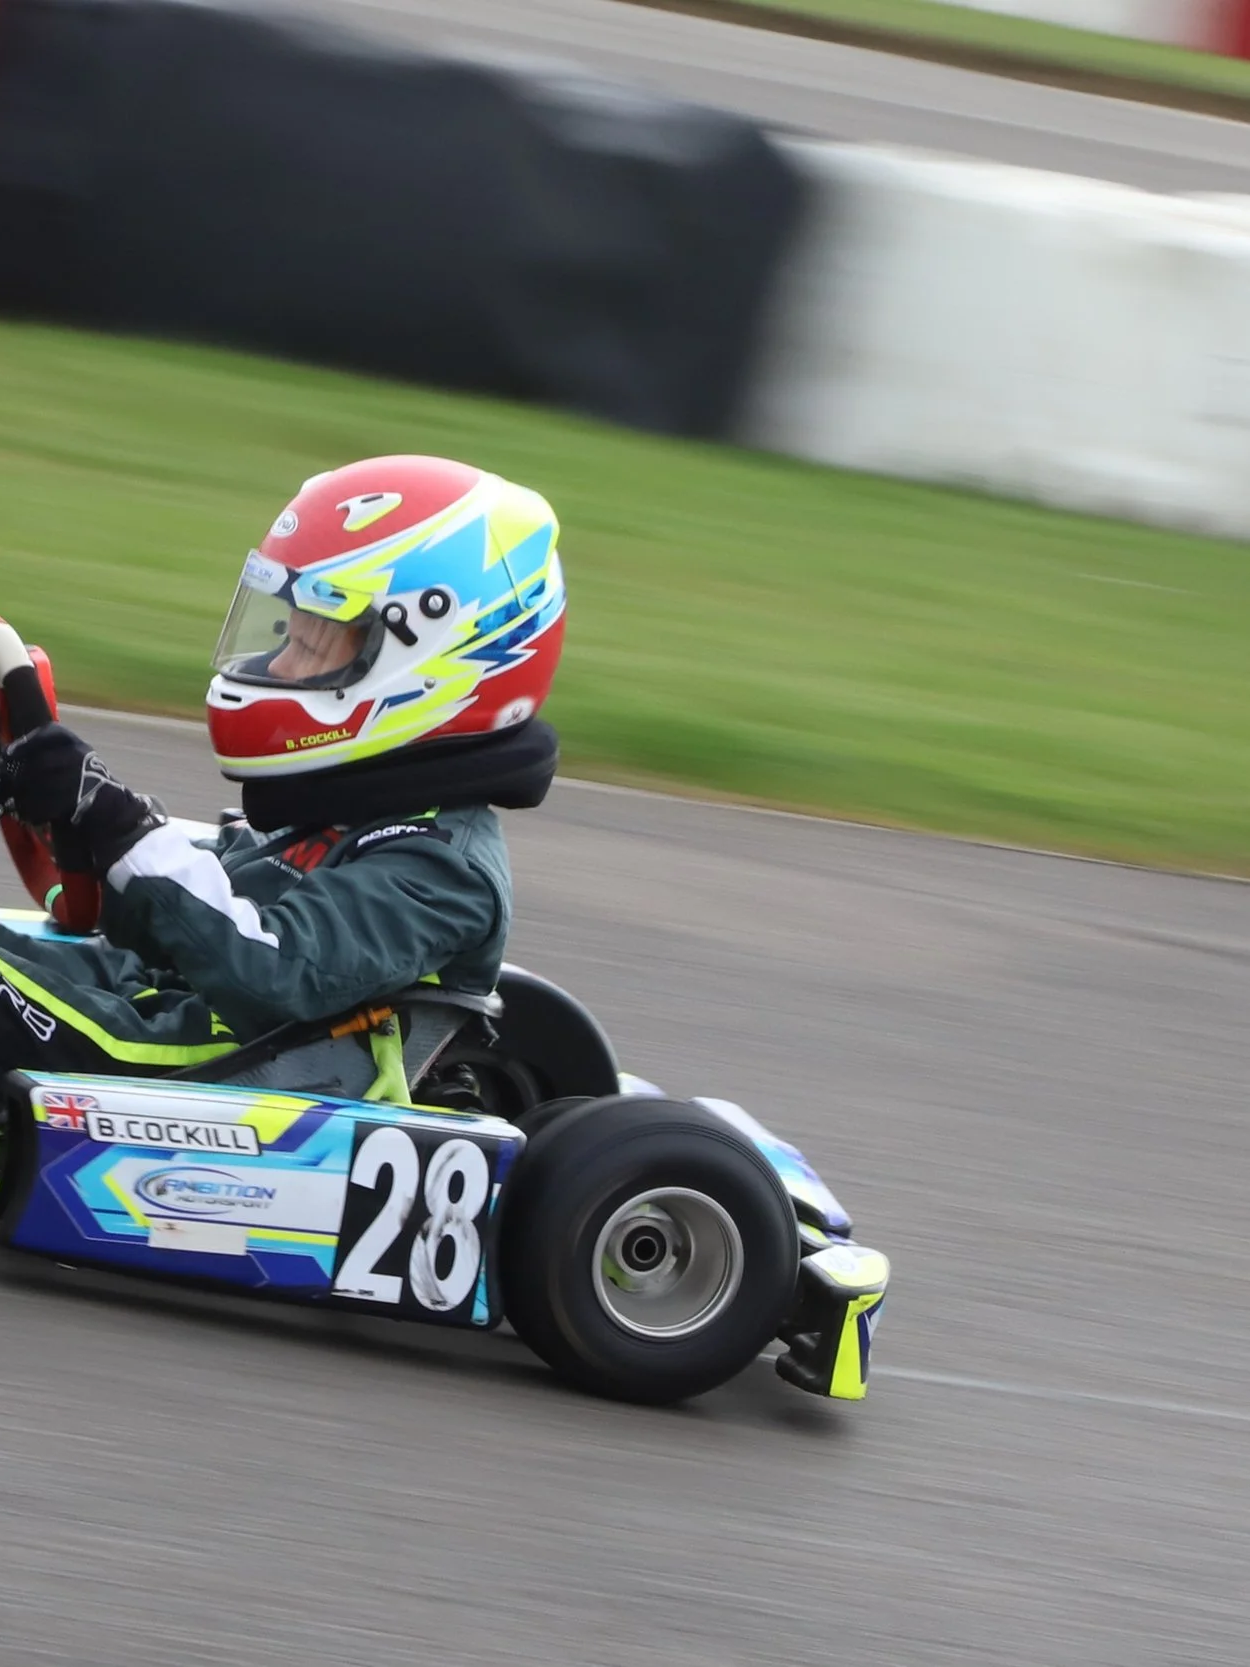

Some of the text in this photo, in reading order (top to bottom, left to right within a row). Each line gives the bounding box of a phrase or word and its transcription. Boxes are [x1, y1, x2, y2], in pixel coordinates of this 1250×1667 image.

[300, 728, 352, 747] COCKILL
[97, 1117, 250, 1151] B.COCKILL
[331, 1126, 490, 1311] 28
